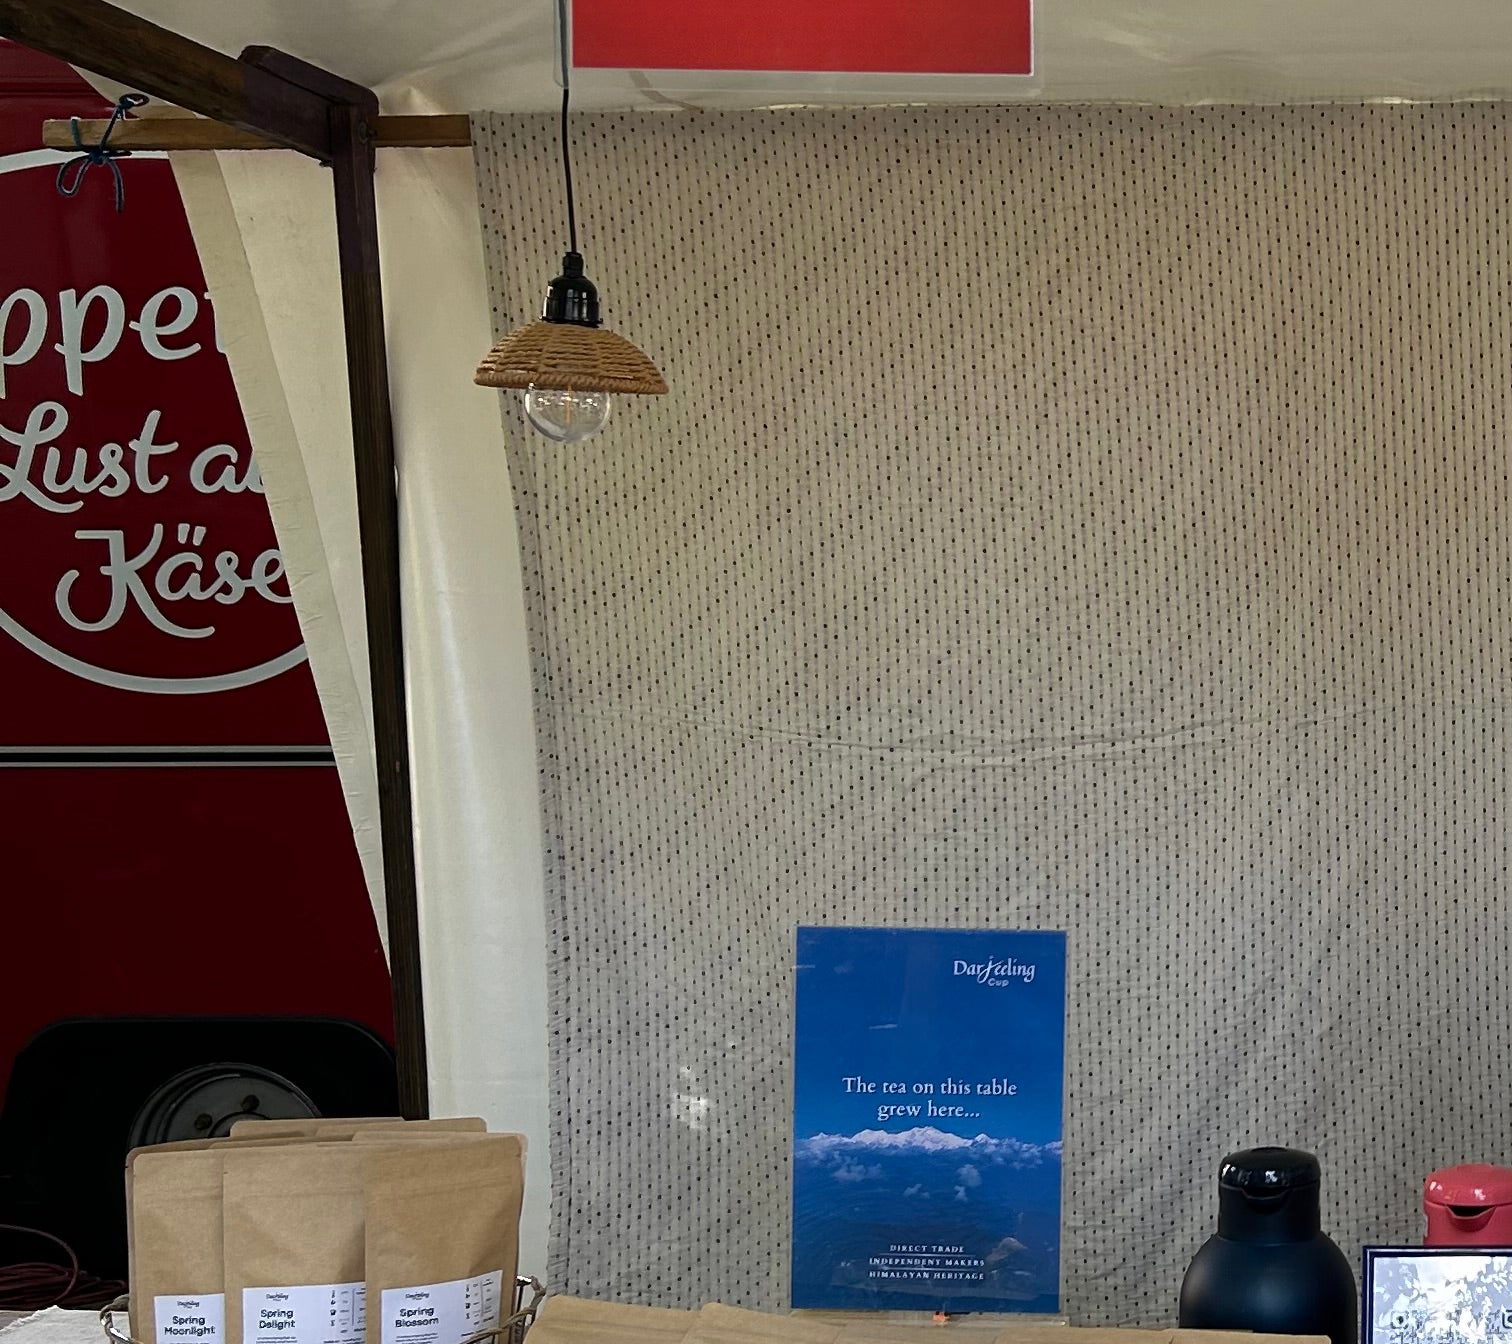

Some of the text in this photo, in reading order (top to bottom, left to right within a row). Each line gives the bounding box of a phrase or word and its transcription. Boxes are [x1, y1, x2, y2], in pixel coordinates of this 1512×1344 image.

[0, 401, 179, 514] Lust
[953, 955, 1036, 984] Darjeeling
[842, 1076, 1018, 1096] The tea on this table
[877, 1100, 980, 1121] grew here...
[890, 1244, 965, 1253] DIRECT TRADE
[868, 1257, 986, 1267] INDEPENDENT MAKERS
[868, 1270, 985, 1280] HIMALAYAN HERITAGE
[259, 1308, 294, 1319] Spring
[399, 1306, 435, 1319] Spring
[172, 1315, 206, 1326] Spring
[164, 1325, 216, 1337] Moonlight
